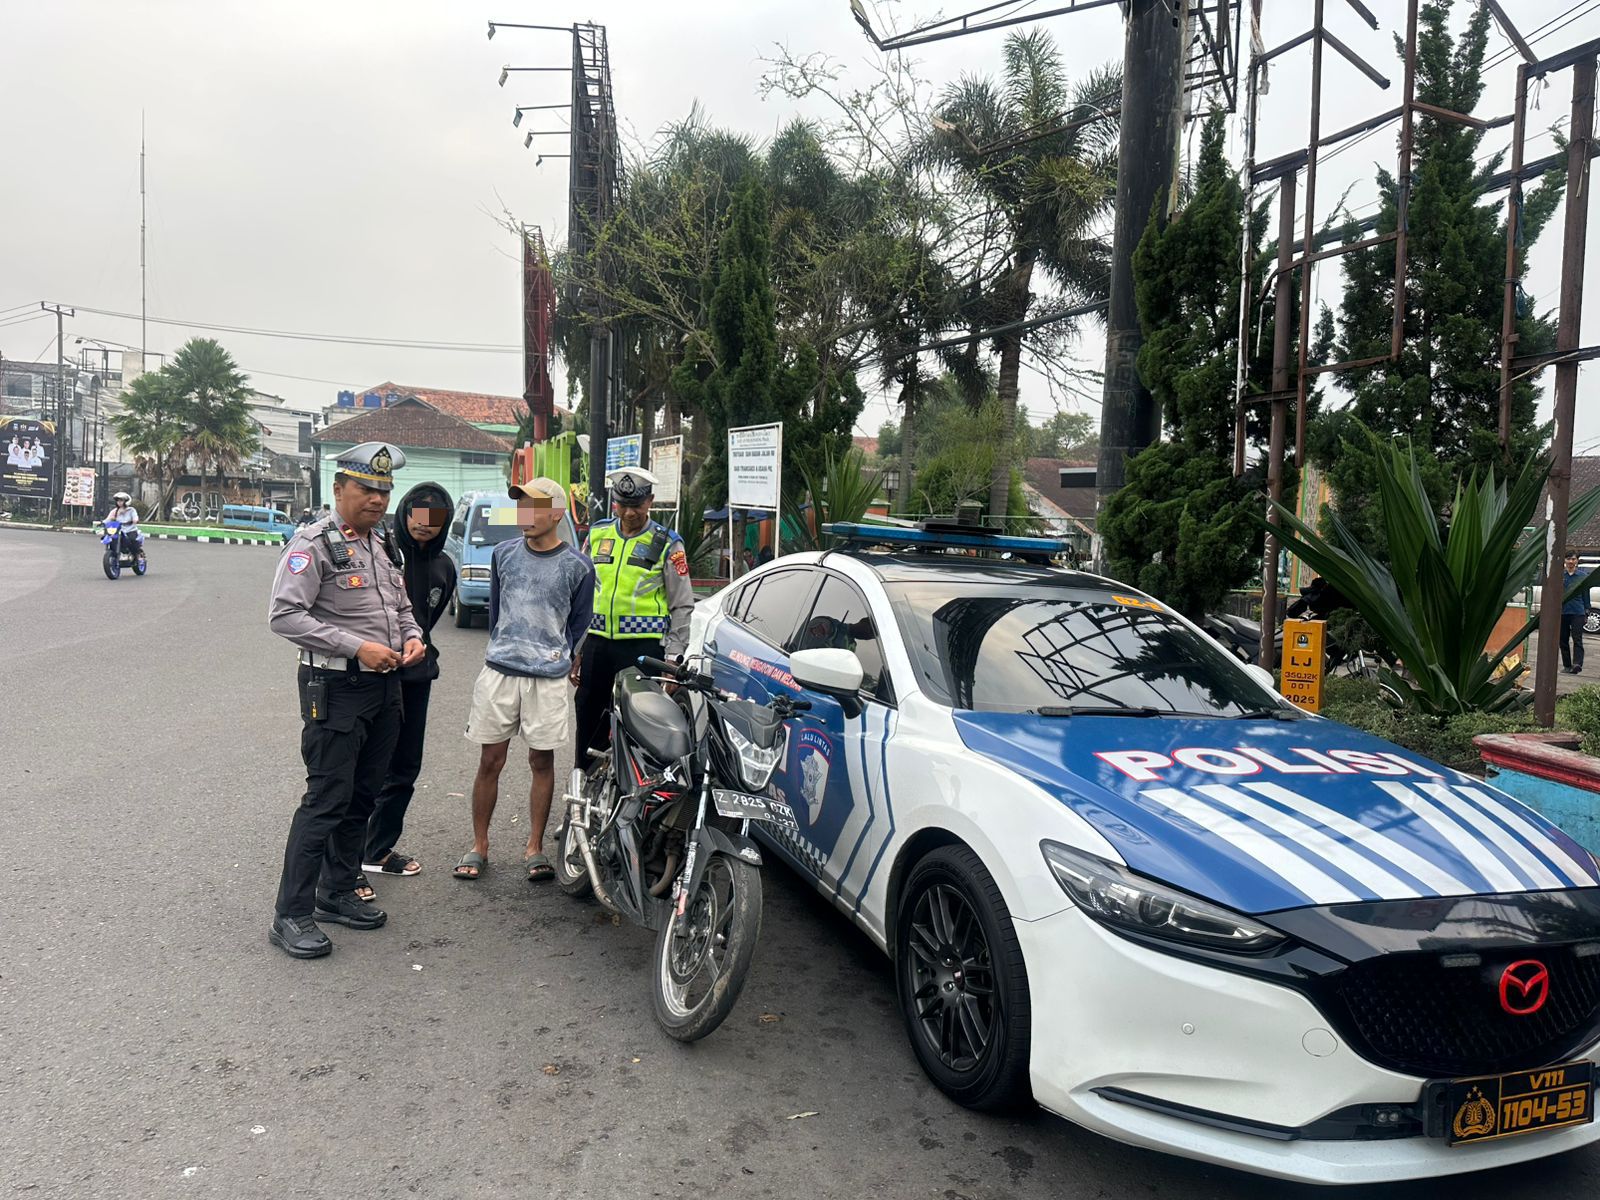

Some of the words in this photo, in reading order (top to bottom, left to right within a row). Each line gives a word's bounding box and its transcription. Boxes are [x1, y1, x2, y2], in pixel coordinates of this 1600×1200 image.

[1285, 694, 1315, 704] 2025
[1093, 746, 1446, 781] POLISI
[716, 791, 728, 803] Z
[732, 793, 766, 808] 2825
[1503, 1089, 1587, 1130] 1104-53
